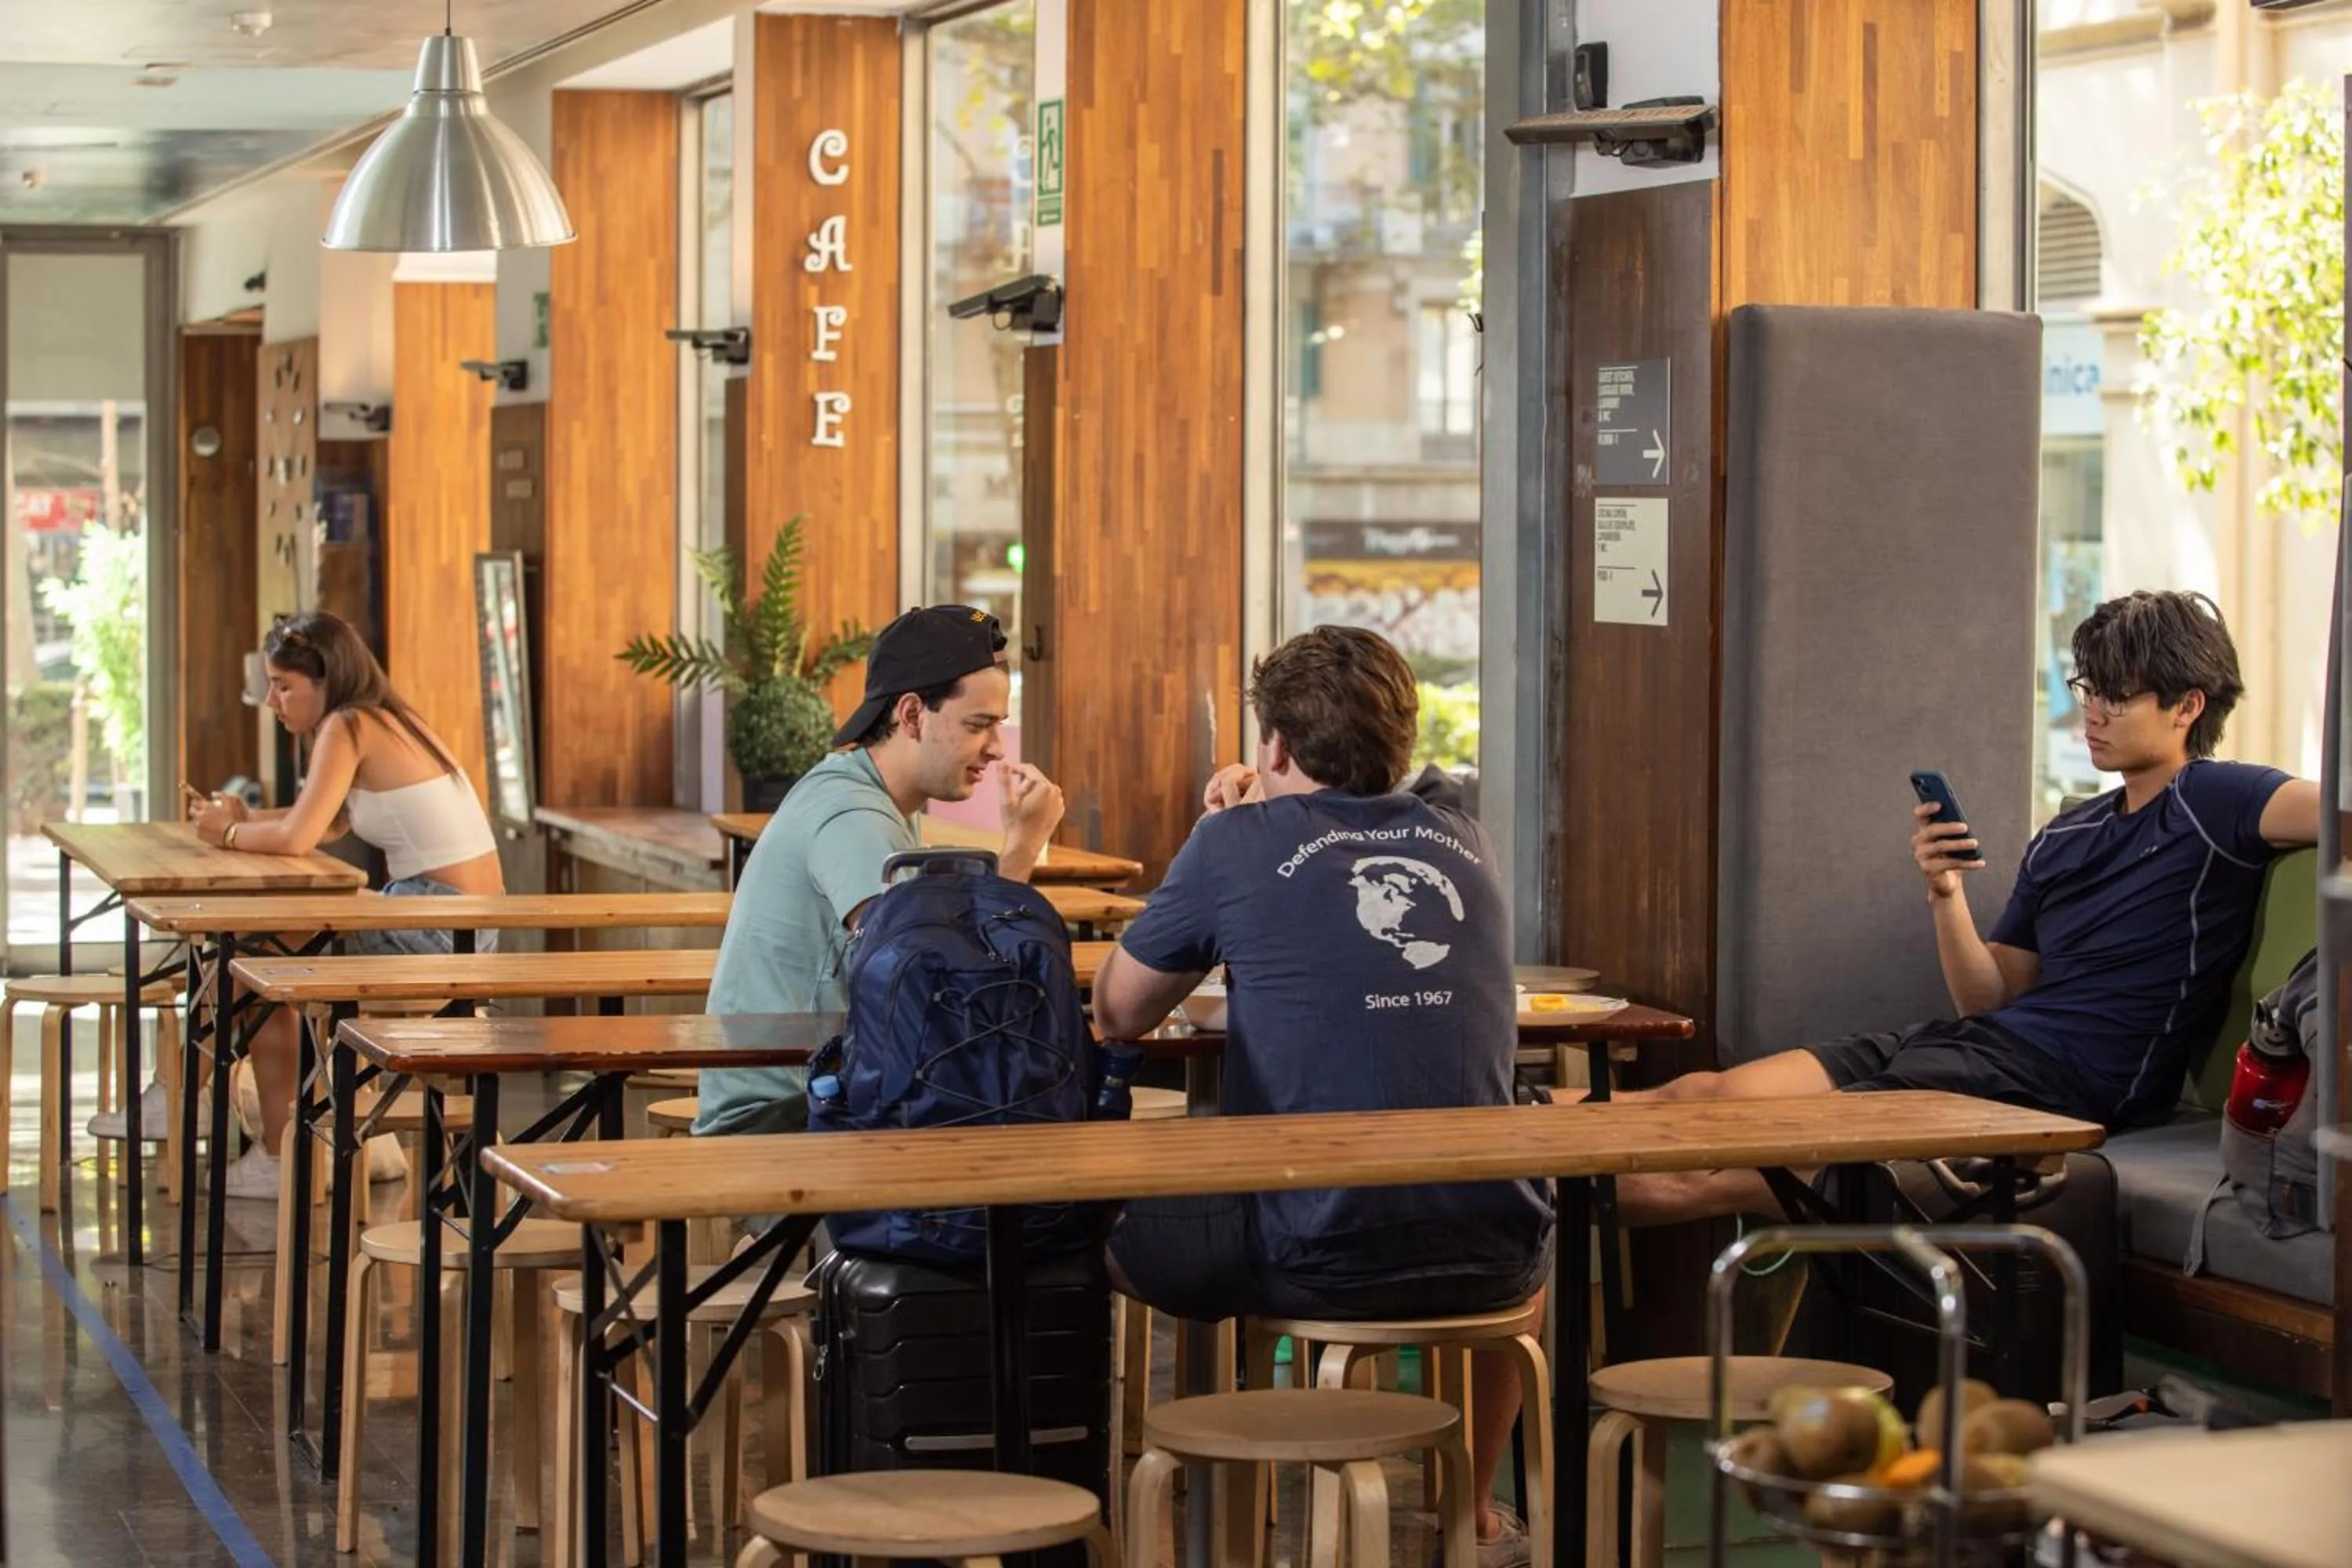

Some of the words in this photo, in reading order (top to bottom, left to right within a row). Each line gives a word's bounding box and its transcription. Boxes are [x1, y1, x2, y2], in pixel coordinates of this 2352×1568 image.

[804, 129, 852, 448] CAFE
[1277, 829, 1365, 877] Defending
[1364, 829, 1410, 840] Your
[1414, 826, 1480, 864] Mother
[1365, 993, 1410, 1010] Since
[1414, 990, 1453, 1006] 1967
